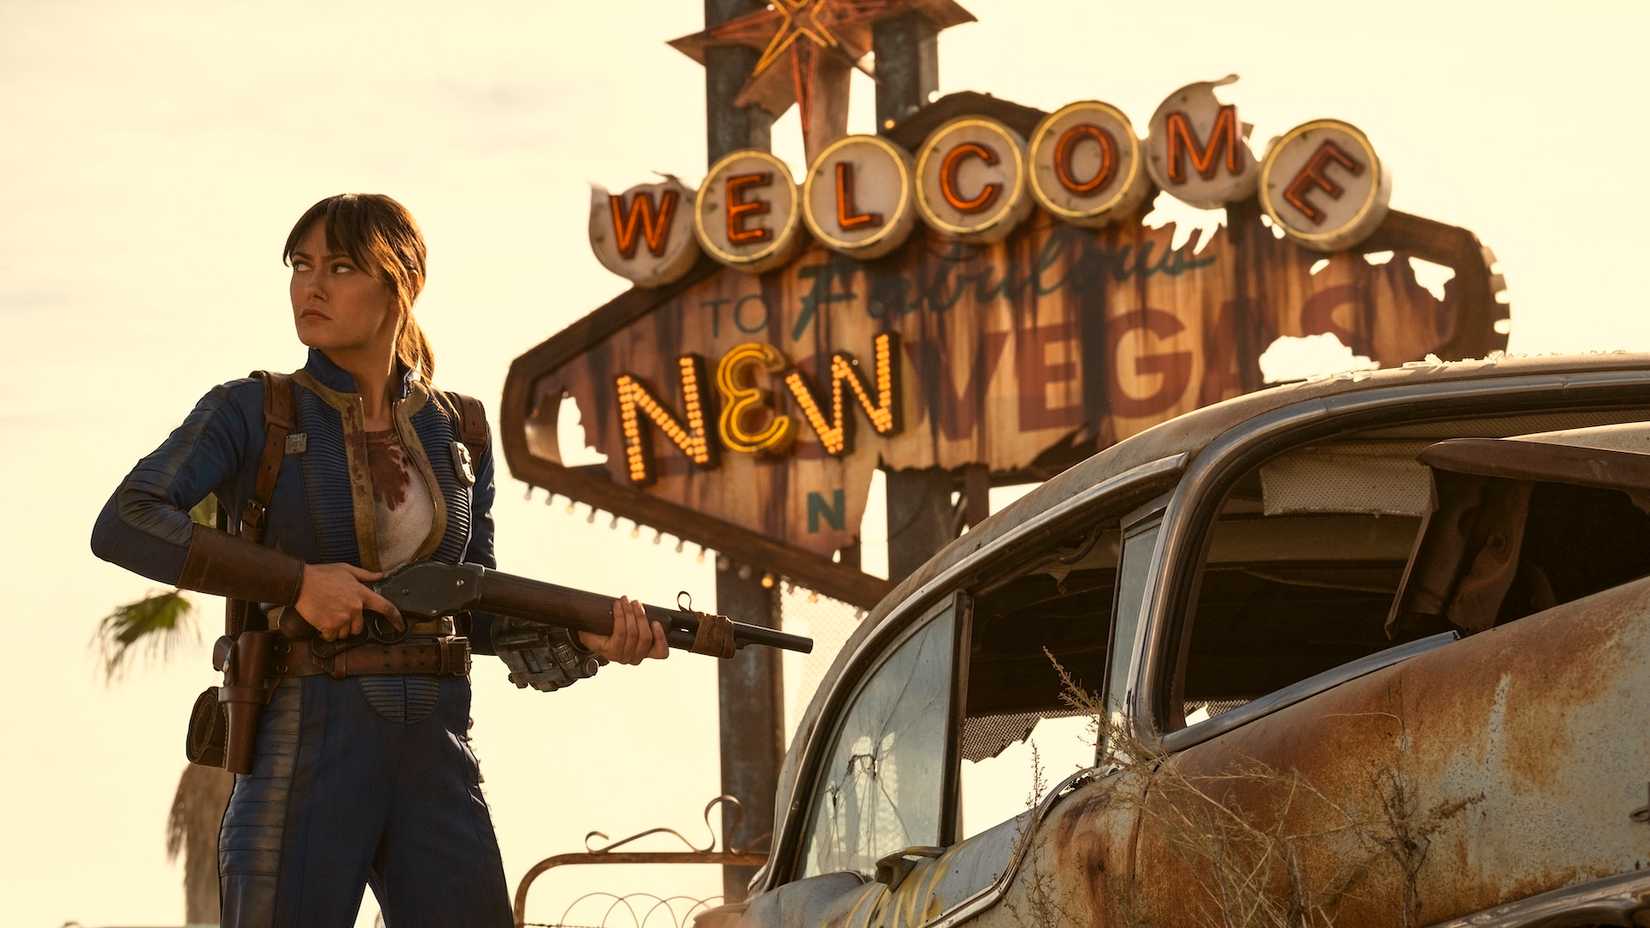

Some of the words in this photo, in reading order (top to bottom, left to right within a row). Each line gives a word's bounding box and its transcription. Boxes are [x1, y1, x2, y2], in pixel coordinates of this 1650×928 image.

[608, 103, 1365, 260] WELCOME
[703, 294, 768, 337] TO
[615, 332, 902, 485] NEW
